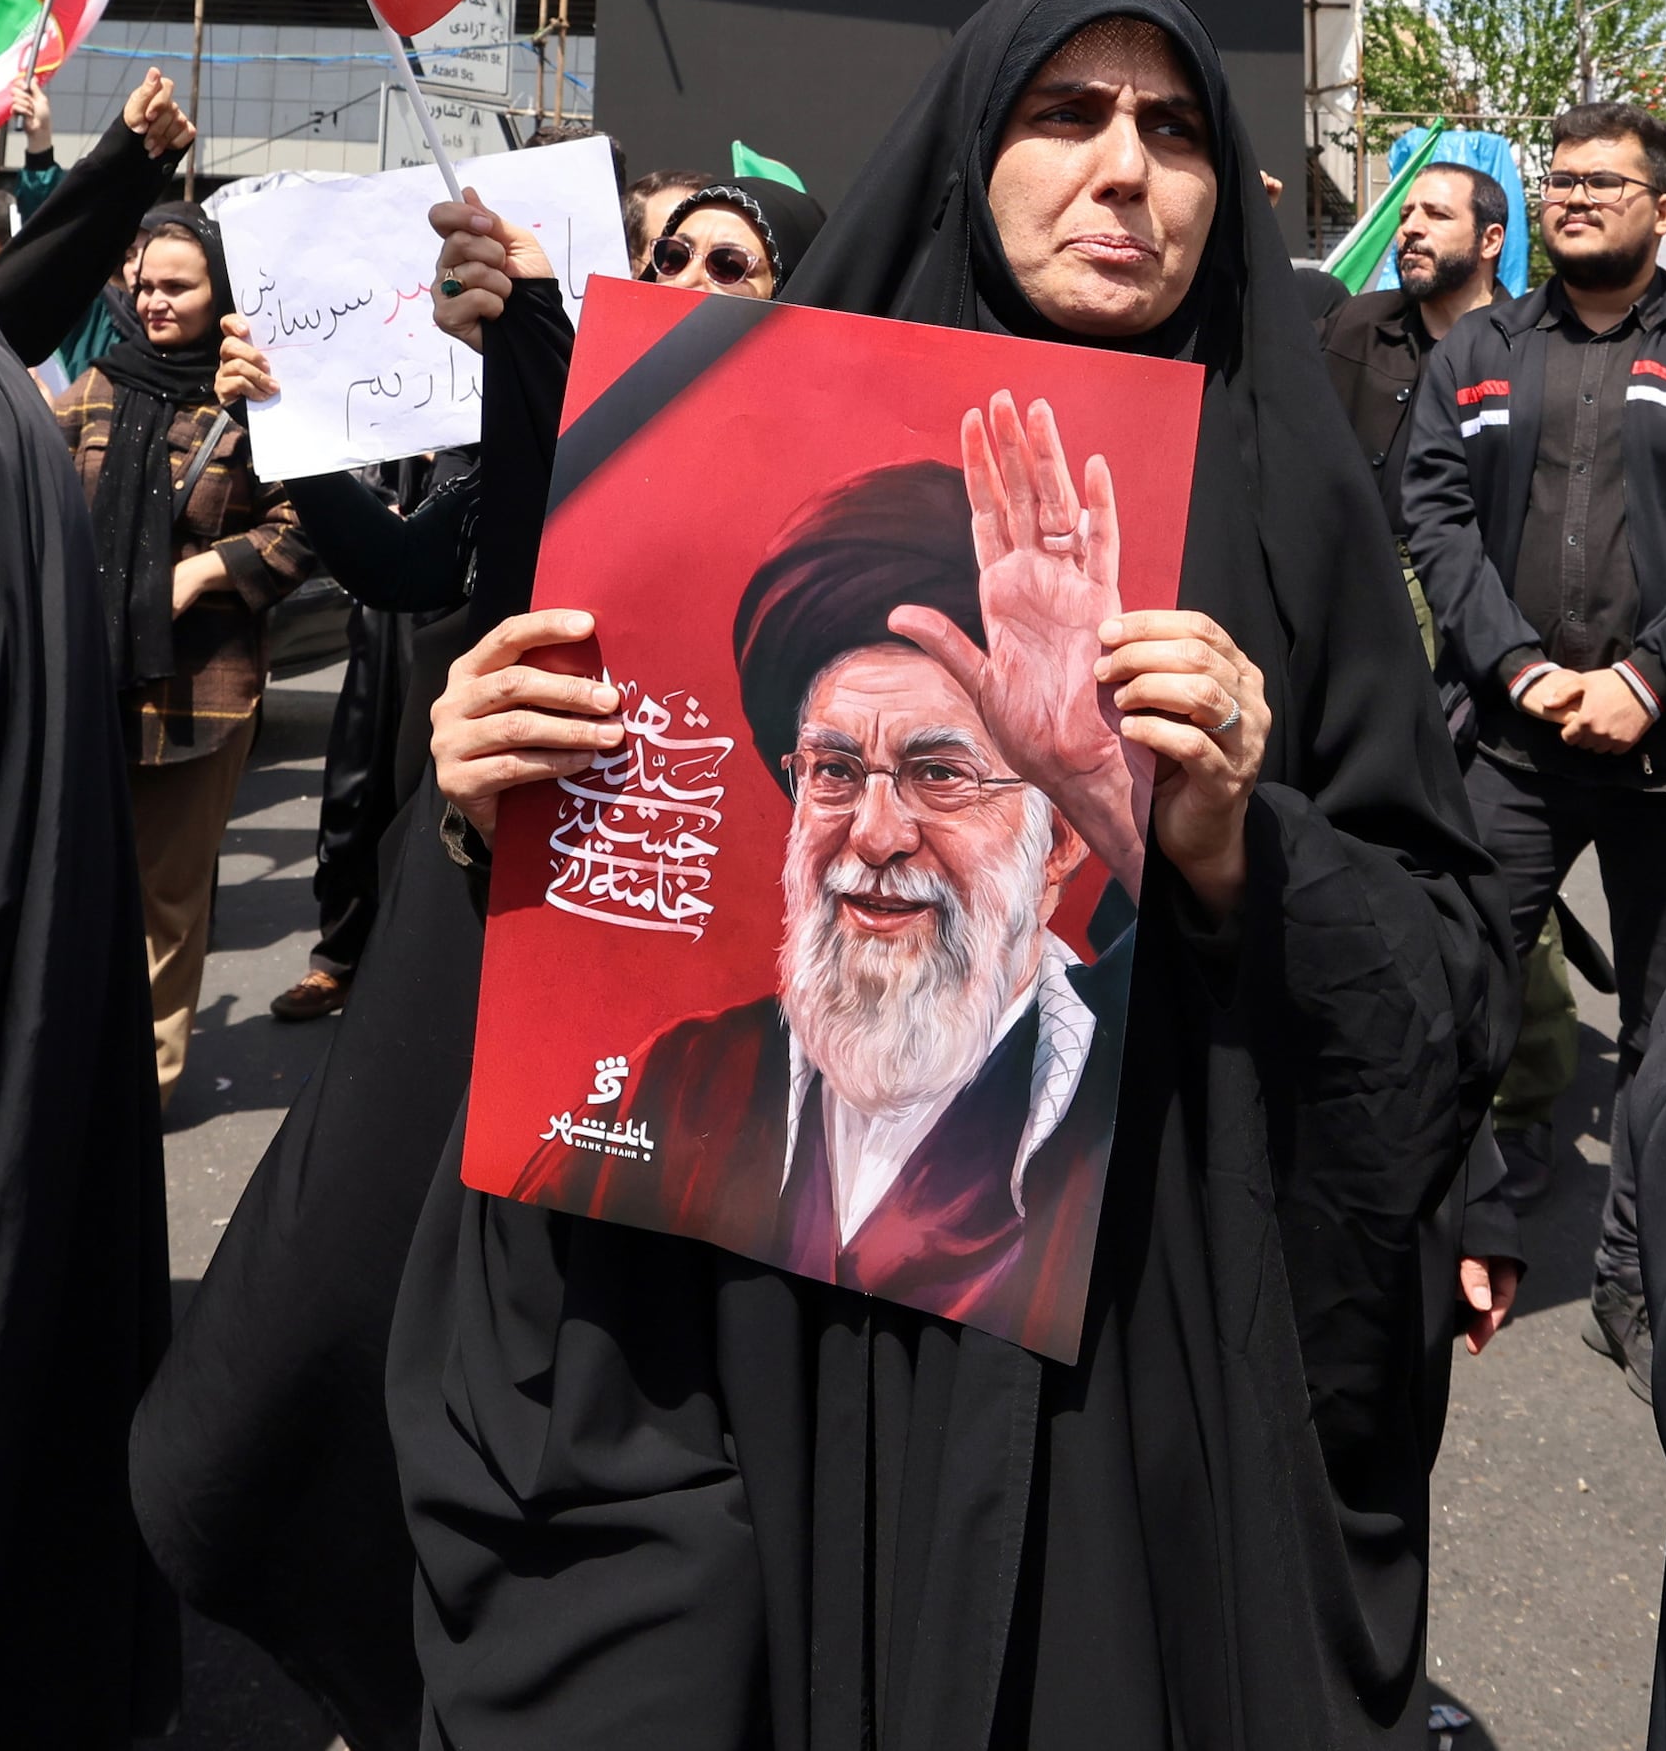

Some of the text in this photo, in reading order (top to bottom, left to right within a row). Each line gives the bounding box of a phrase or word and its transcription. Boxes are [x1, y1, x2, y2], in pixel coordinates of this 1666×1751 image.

[449, 23, 485, 40] آزادی
[431, 65, 459, 78] Azadi
[346, 344, 484, 441] داریم
[539, 1111, 606, 1146] شهر
[575, 1139, 638, 1160] BANK SHAHR
